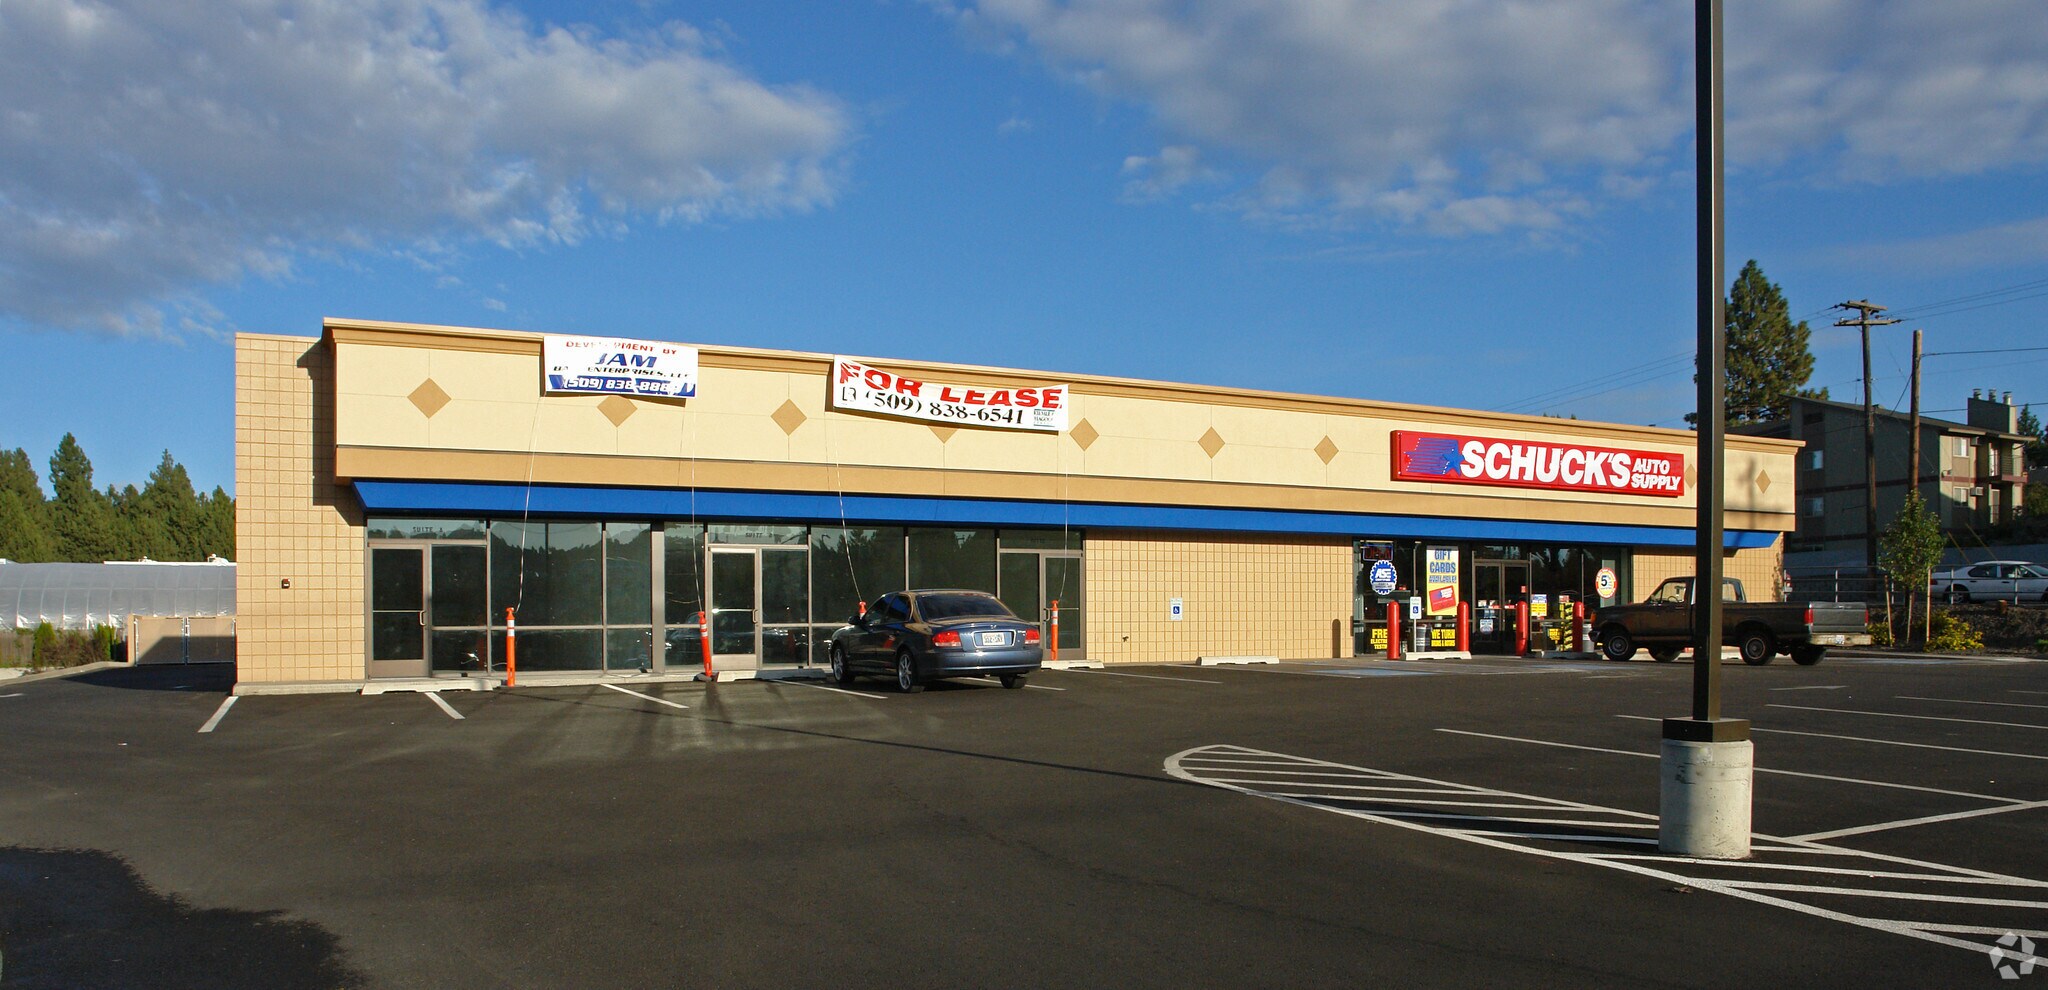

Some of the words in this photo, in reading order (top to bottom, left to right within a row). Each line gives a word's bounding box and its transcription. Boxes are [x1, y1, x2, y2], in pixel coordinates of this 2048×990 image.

[594, 353, 658, 368] JAM
[562, 376, 604, 390] (509)
[840, 362, 923, 398] FOR
[939, 386, 1063, 409] LEASE
[865, 389, 923, 414] (509)
[929, 402, 1025, 425] 838-6541
[1459, 440, 1632, 487] SCHUCK'S
[1632, 457, 1671, 475] AUTO
[1630, 473, 1682, 491] SUPPLY
[1434, 549, 1452, 560] GIFT
[1374, 568, 1392, 579] ASE
[1429, 562, 1456, 574] CARDS
[1429, 575, 1457, 584] AVAILABLE!
[1600, 574, 1608, 587] 5
[1371, 628, 1388, 639] FRE
[1431, 628, 1441, 639] WE
[1441, 628, 1456, 639] TURN
